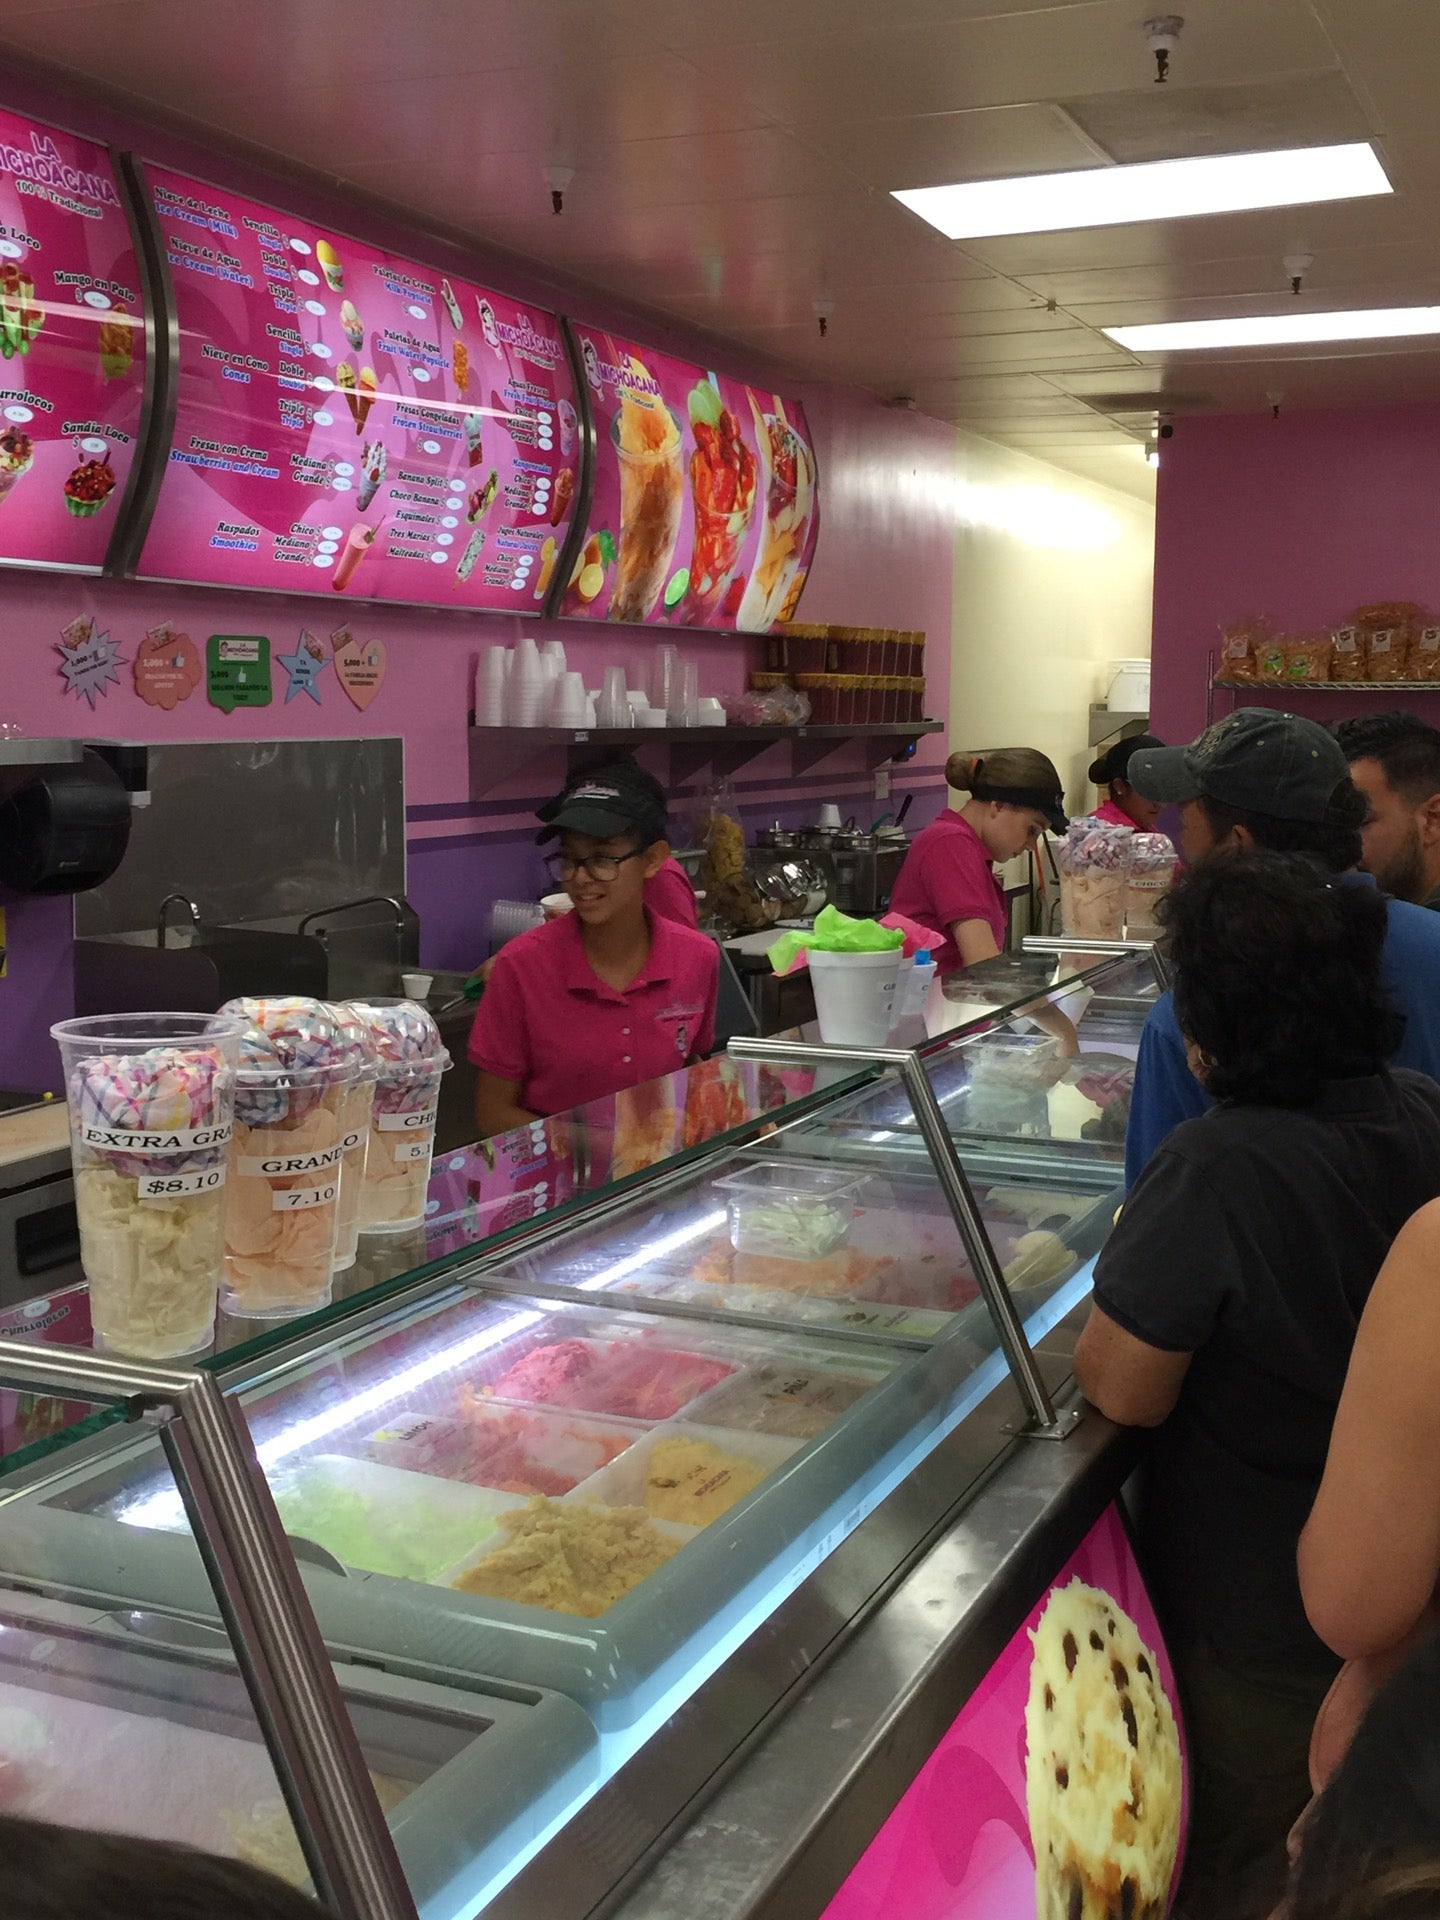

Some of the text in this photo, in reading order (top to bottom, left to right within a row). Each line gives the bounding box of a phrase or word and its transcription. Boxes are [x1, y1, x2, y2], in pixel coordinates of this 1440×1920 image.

[30, 131, 61, 163] LA
[48, 190, 103, 219] Tradicional
[155, 187, 231, 220] Nieve de Leche
[155, 202, 238, 239] Ice Cream (Milk)
[243, 217, 280, 238] Sencilla
[11, 227, 41, 251] Loco
[170, 238, 242, 270] Nieve de Agua
[261, 251, 288, 268] Doble
[183, 256, 216, 276] Cream
[217, 265, 254, 288] (Water)
[263, 265, 291, 281] Double
[54, 271, 136, 302] Mango en Palo
[267, 282, 296, 302] Triple
[413, 277, 436, 294] Crema
[266, 323, 303, 342] Sencilla
[383, 328, 440, 353] Paletas de Agua
[202, 345, 230, 363] Nieve
[231, 354, 244, 365] en
[278, 341, 304, 357] Single
[222, 366, 251, 384] Cones
[279, 361, 304, 378] Doble
[597, 361, 662, 399] MICHOACANA
[0, 388, 54, 413] urrolocos
[279, 399, 304, 415] Triple
[396, 402, 460, 426] Fresas Congeladas
[104, 425, 130, 445] Loca
[392, 416, 463, 440] Frozen Strawberries
[189, 436, 268, 461] Fresas con Crema
[170, 449, 279, 479] Strawberries and Cream
[293, 469, 324, 485] Grande
[398, 471, 425, 486] Banana
[425, 475, 443, 489] Split
[389, 489, 412, 502] Choco
[413, 492, 440, 506] Banana
[395, 508, 435, 525] Esquimales
[216, 520, 260, 538] Raspados
[290, 522, 315, 536] Chico
[389, 527, 406, 539] Tres
[209, 536, 259, 552] Smoothies
[388, 546, 425, 560] Malteadas
[274, 550, 305, 563] Grande
[86, 1129, 182, 1148] EXTRA
[147, 1172, 220, 1194] $8.10
[288, 1187, 334, 1205] 7.10
